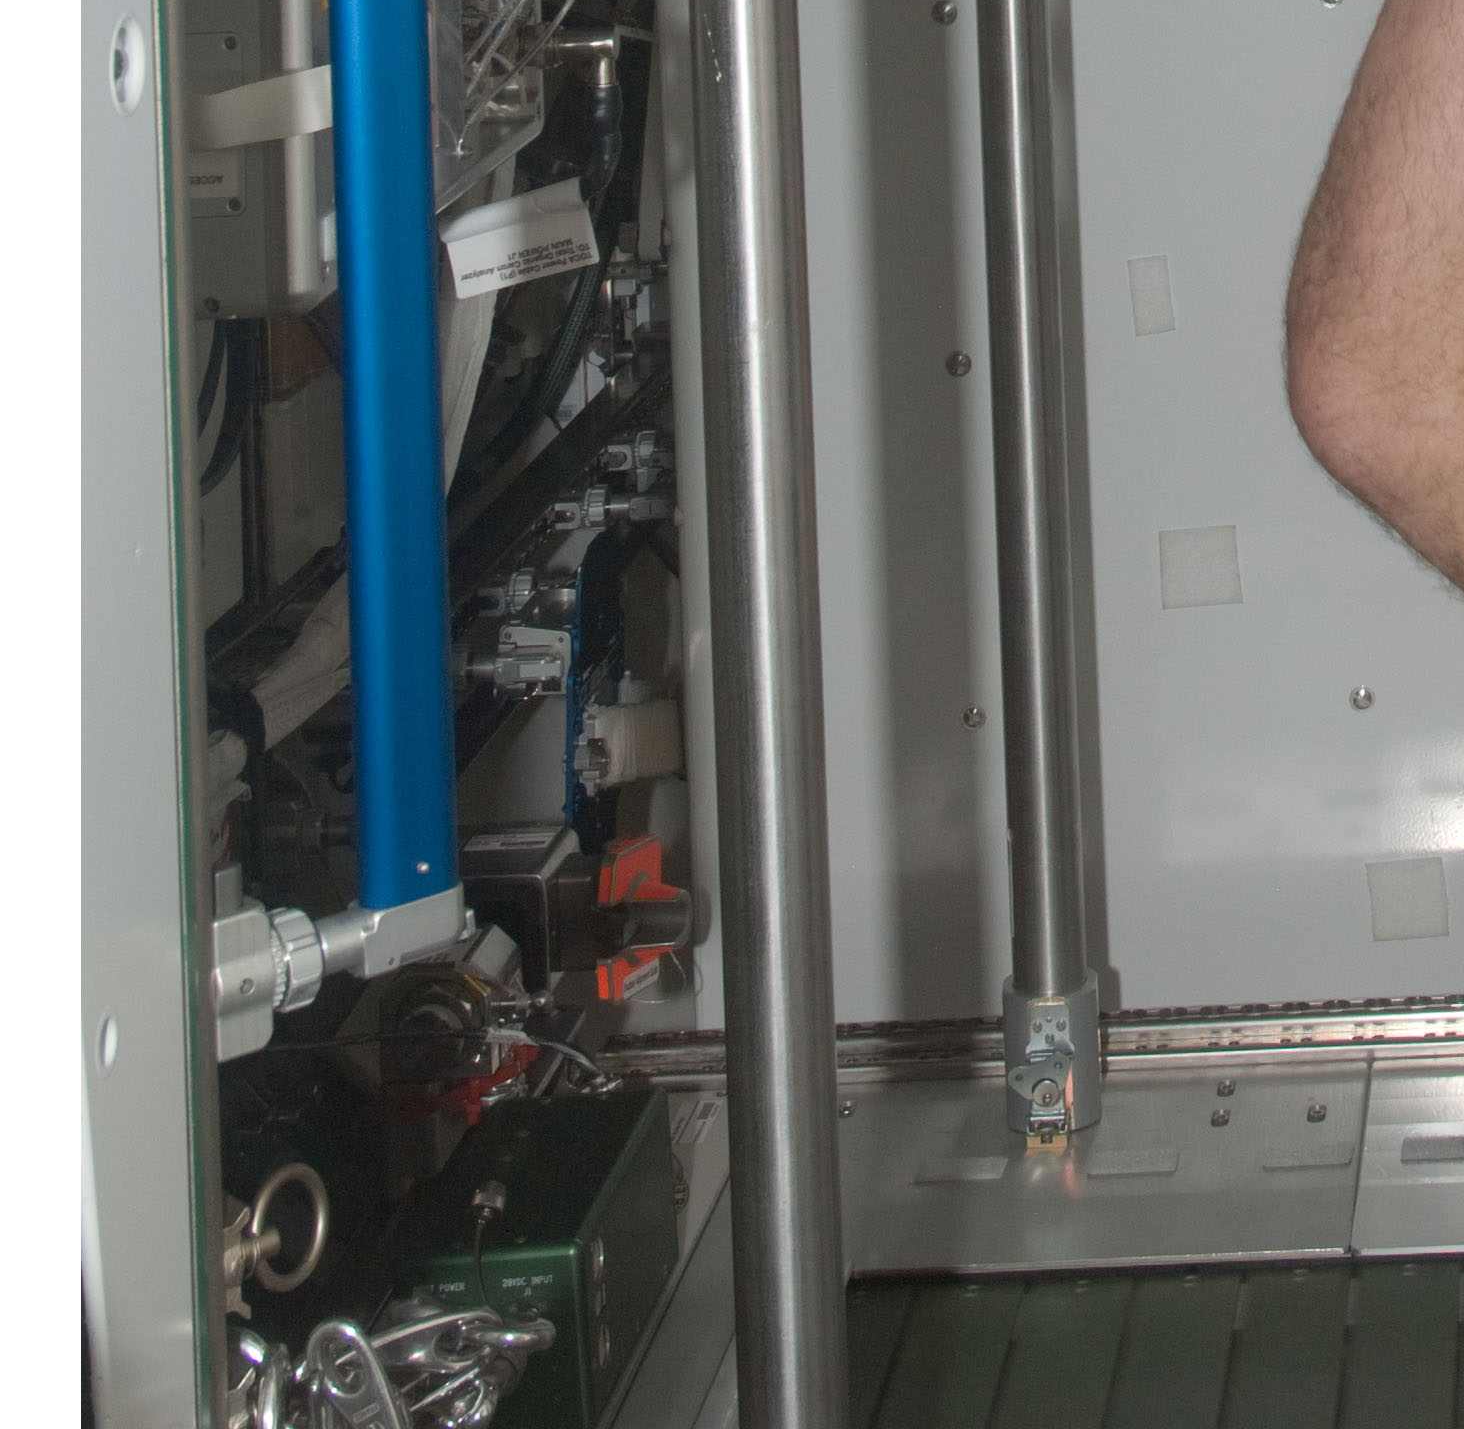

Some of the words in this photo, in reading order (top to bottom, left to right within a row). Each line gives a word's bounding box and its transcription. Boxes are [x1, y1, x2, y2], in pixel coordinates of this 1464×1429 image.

[187, 175, 225, 186] ACCE
[518, 242, 549, 258] POWER
[549, 237, 574, 250] MAIN
[506, 251, 517, 262] J1
[522, 251, 555, 265] Organic
[555, 247, 576, 258] Total
[568, 251, 593, 264] TOCA
[496, 259, 521, 272] Caron
[518, 263, 541, 277] Cable
[542, 257, 567, 270] Power
[460, 266, 495, 282] Analyzer
[499, 269, 517, 282] (P1)
[439, 1281, 466, 1293] POWER
[502, 1275, 527, 1288] 28VDC
[531, 1274, 554, 1286] INPUT
